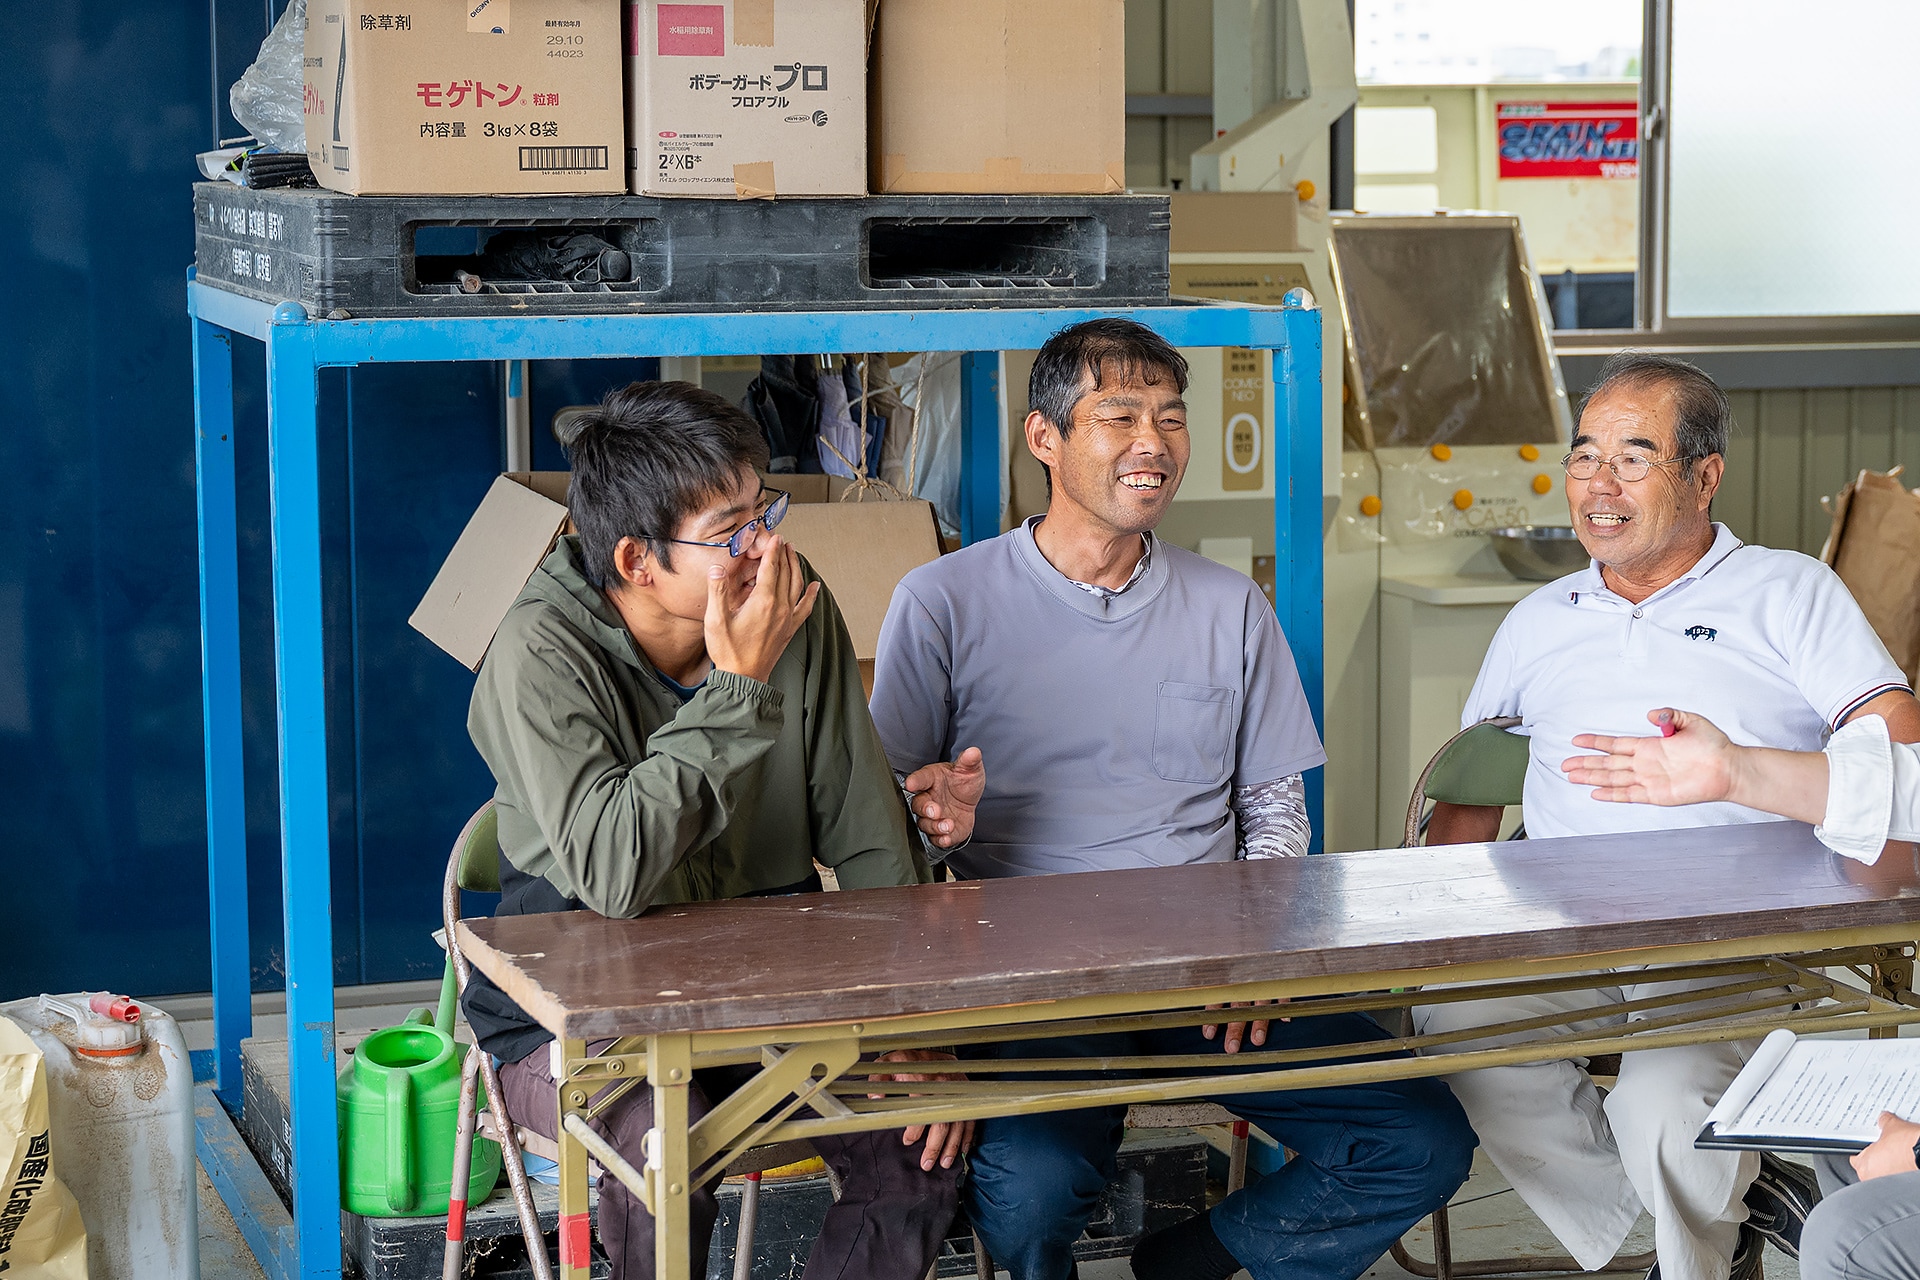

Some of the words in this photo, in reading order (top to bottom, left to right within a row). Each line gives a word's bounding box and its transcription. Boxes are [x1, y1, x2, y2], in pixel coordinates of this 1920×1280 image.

[360, 14, 412, 31] 除草剤
[544, 20, 581, 28] 最終有効年月
[669, 26, 714, 35] 水稲用除草剤
[546, 35, 584, 46] 29.10
[546, 49, 584, 58] 44023
[533, 93, 560, 106] 粒剤
[731, 96, 790, 108] フロアブル
[420, 121, 467, 138] 内容量
